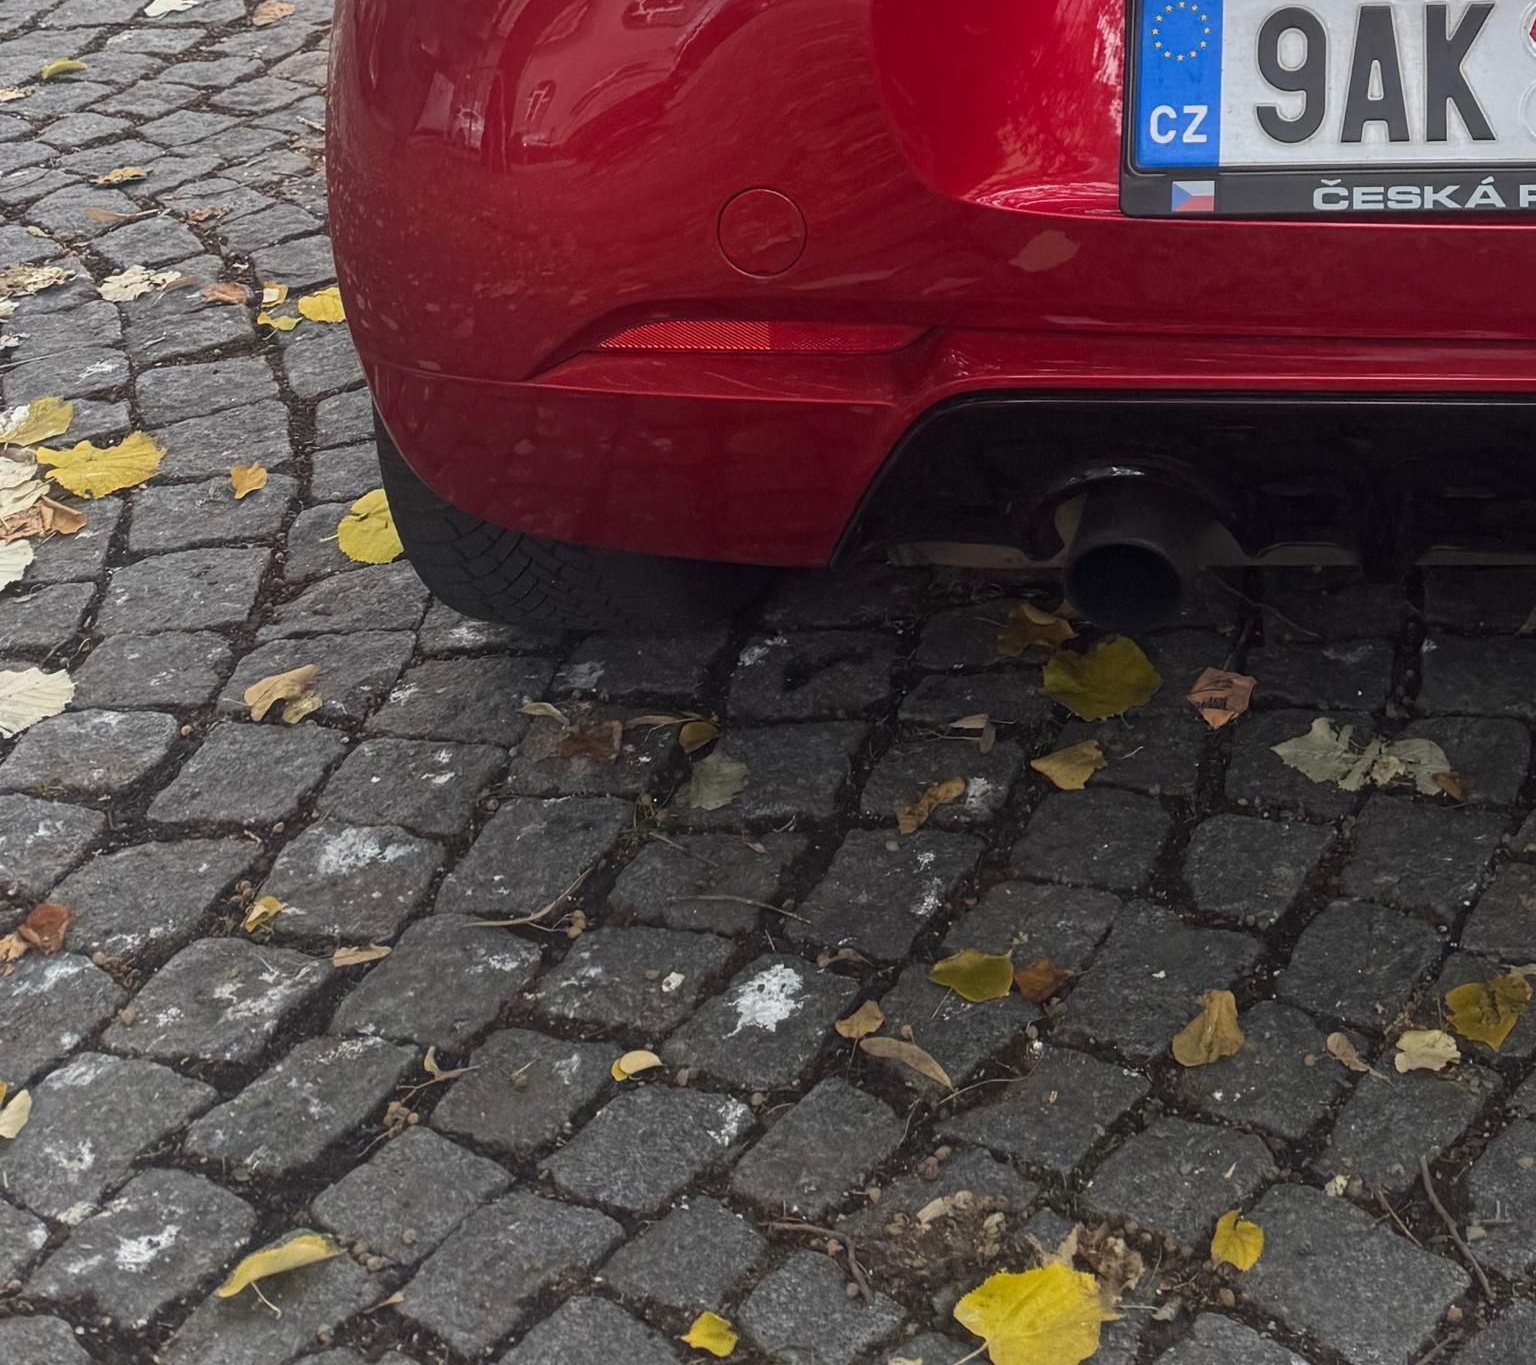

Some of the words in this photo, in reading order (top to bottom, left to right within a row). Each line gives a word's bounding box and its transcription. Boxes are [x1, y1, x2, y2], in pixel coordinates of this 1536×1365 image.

[1255, 1, 1497, 144] 9AK
[1149, 105, 1208, 144] CZ
[1312, 175, 1505, 210] ČESKÁ
